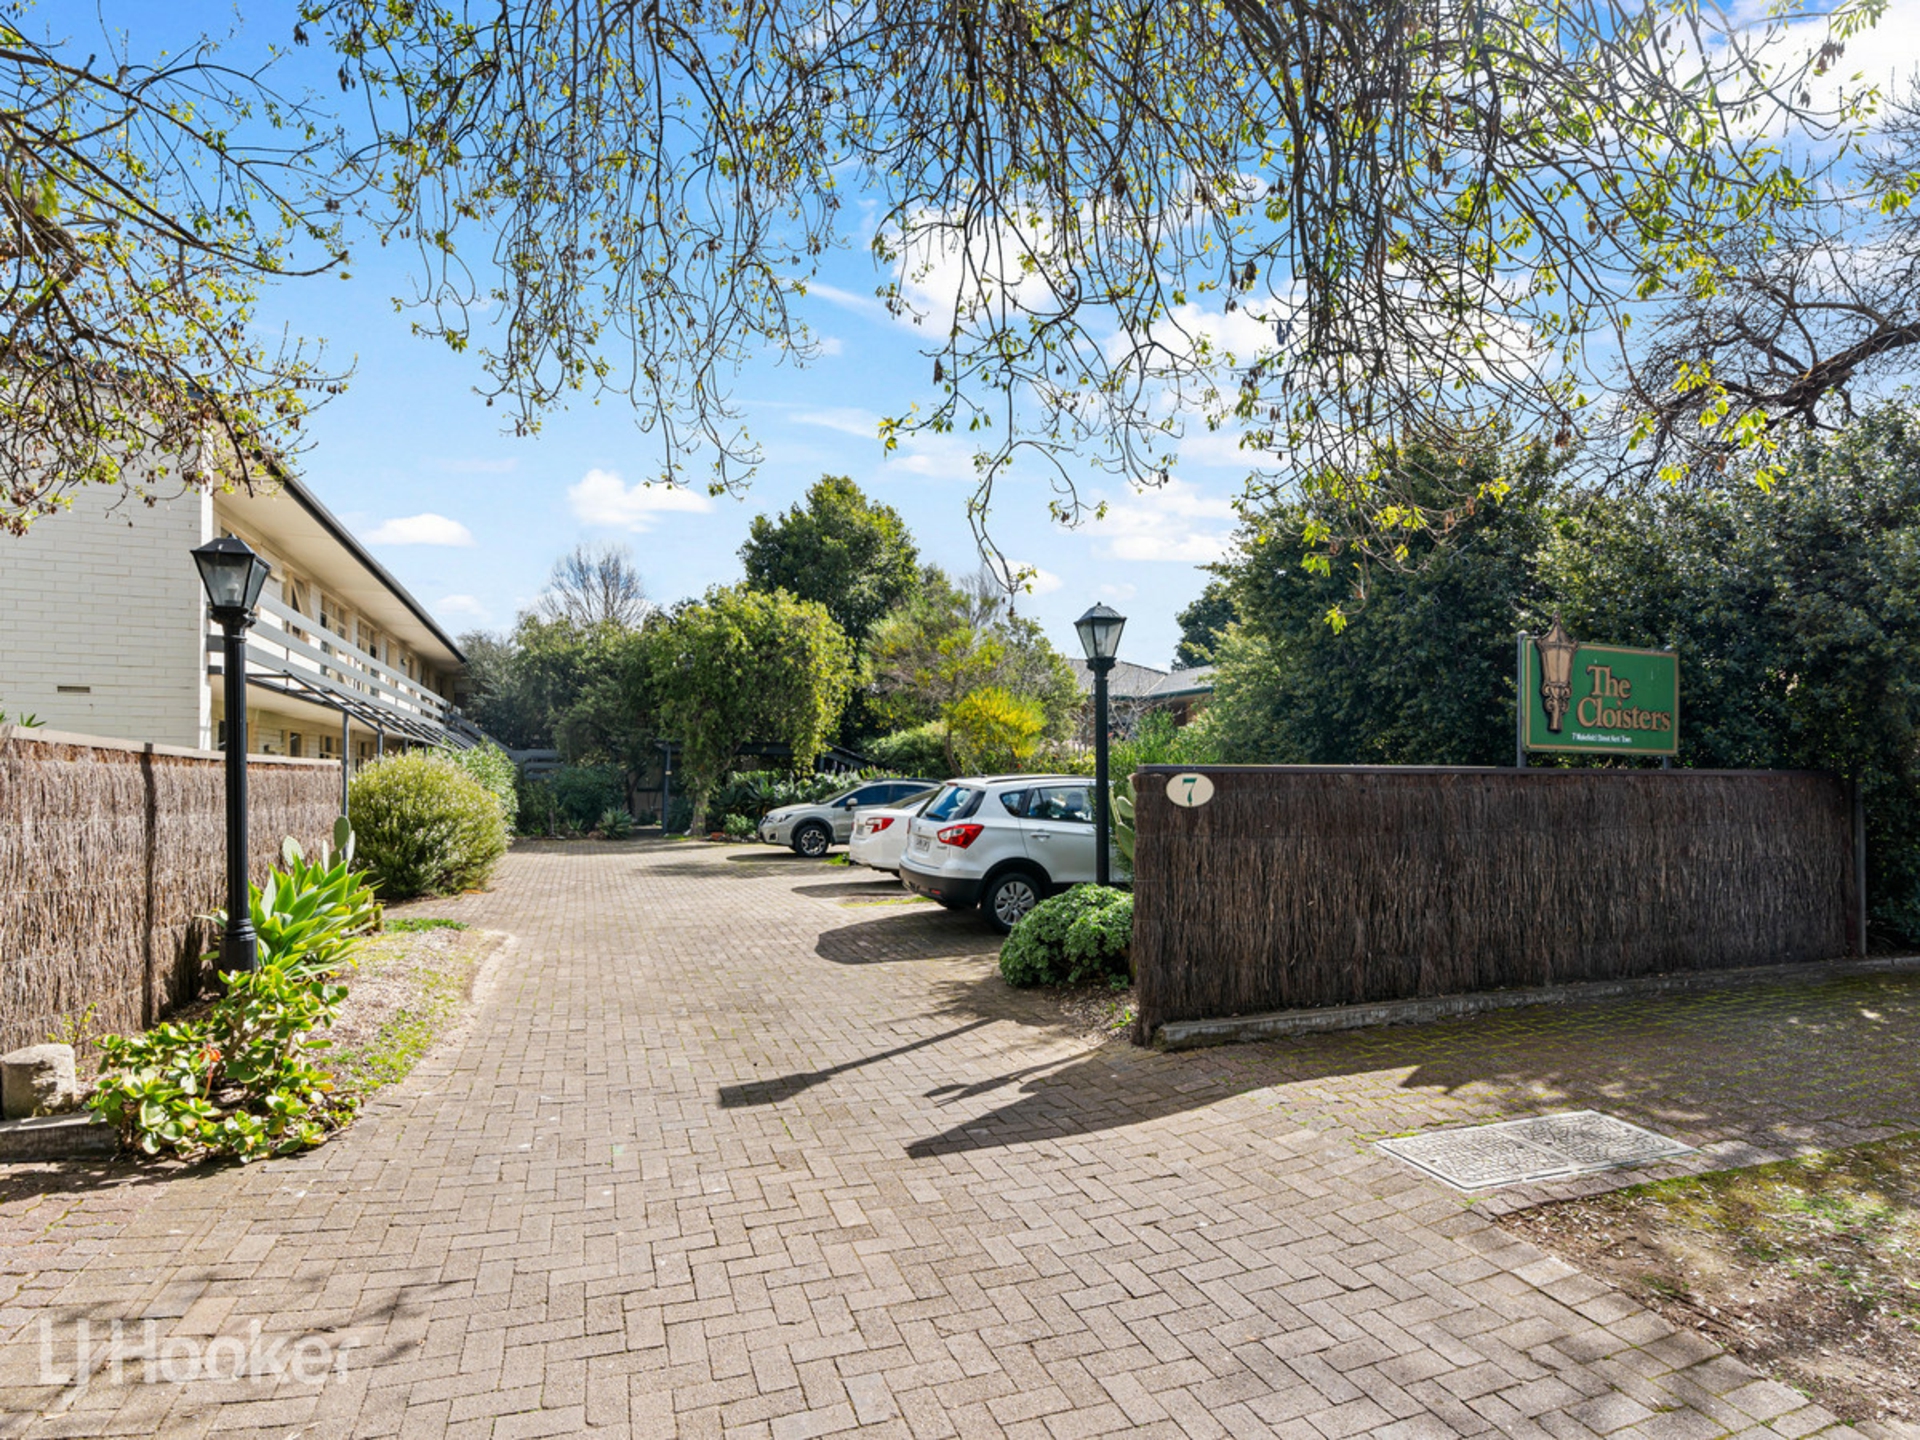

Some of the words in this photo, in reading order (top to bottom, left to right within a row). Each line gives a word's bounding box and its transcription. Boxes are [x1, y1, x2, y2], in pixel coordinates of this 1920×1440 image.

[1586, 665, 1631, 698] The
[1577, 697, 1671, 731] Cloisters
[1182, 778, 1197, 806] 7
